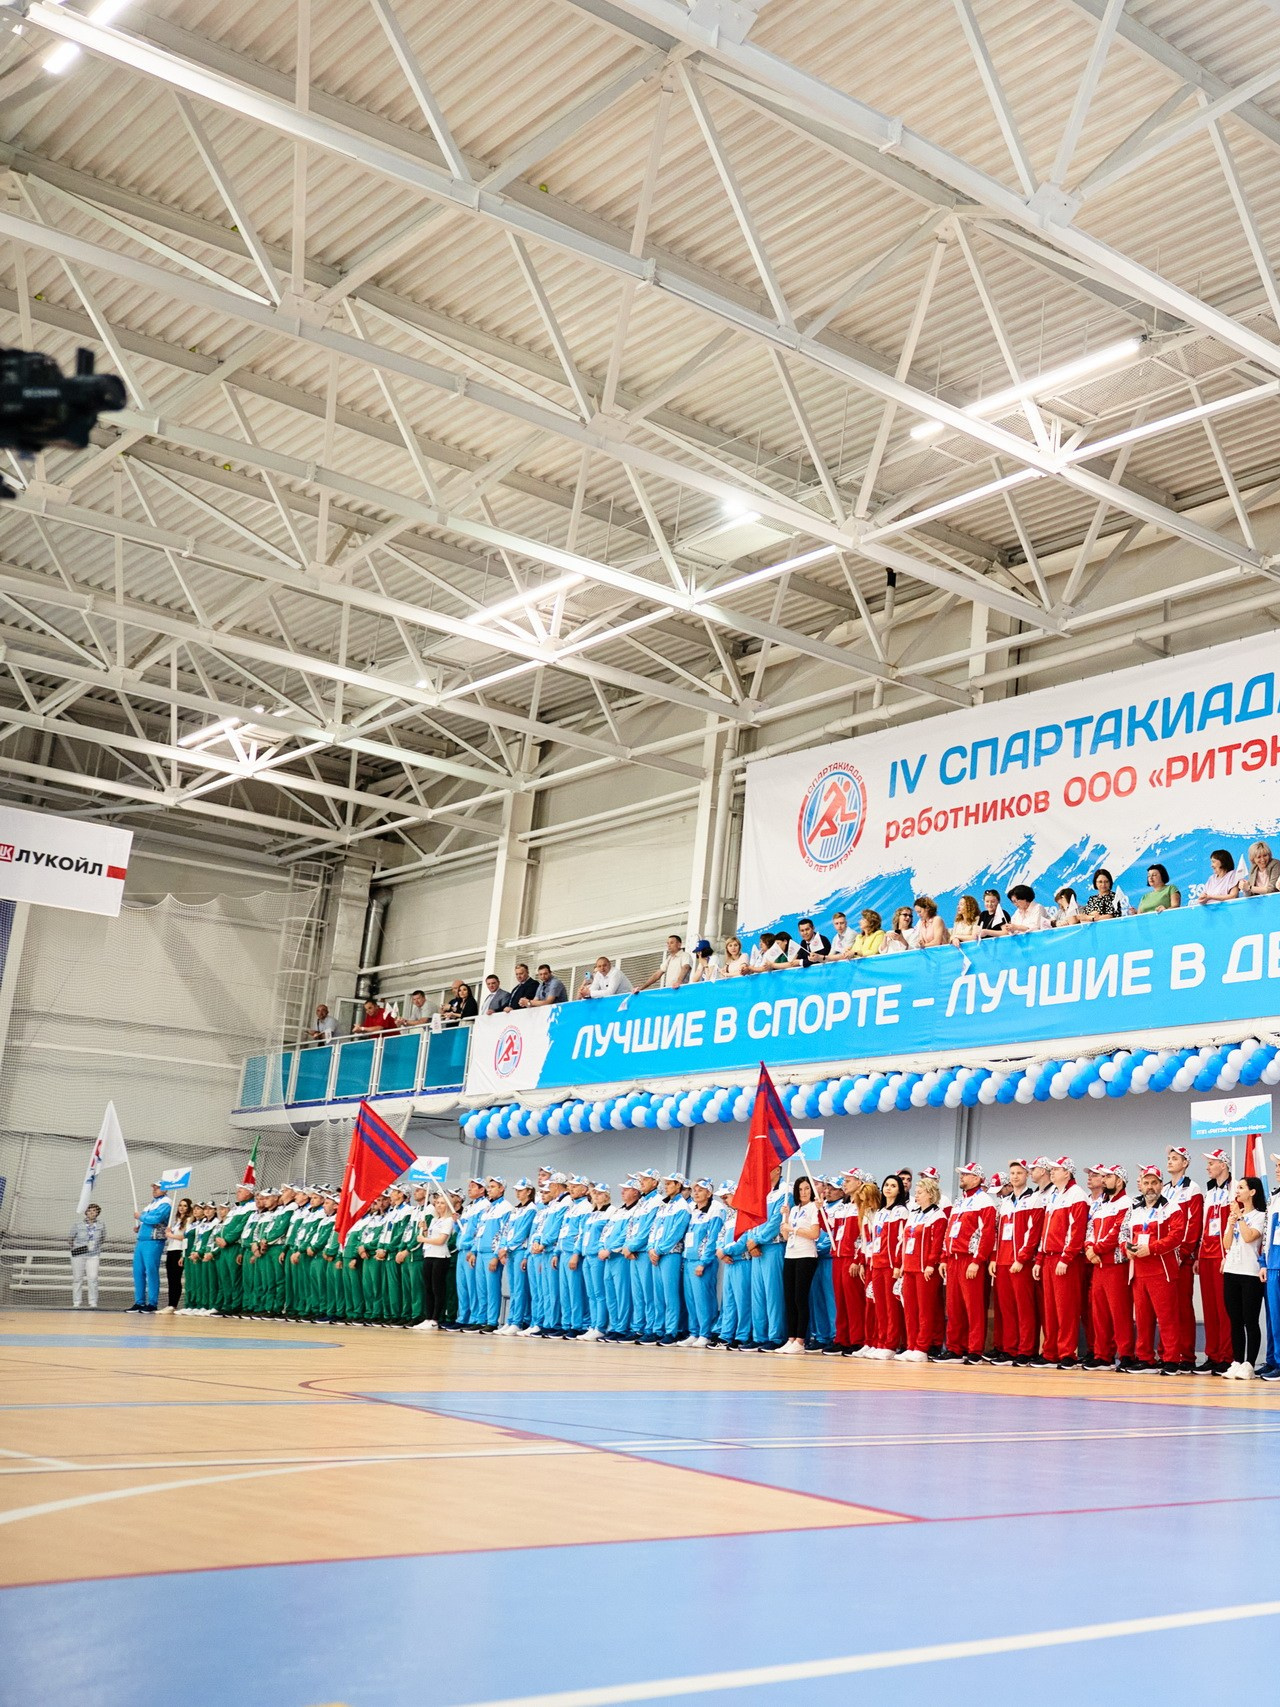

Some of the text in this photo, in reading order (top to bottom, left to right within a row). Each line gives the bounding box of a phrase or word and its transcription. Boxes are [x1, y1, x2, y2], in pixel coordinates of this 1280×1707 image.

[807, 762, 863, 794] СПАРТАКИАДА
[888, 754, 927, 798] IV
[885, 790, 1050, 848] работников
[1063, 765, 1137, 807] ООО
[15, 848, 103, 876] ЛУКОЙЛ
[815, 863, 828, 872] ЛЕТ
[571, 1010, 707, 1060] ЛУЧШИЕ
[713, 1006, 738, 1044] В
[748, 984, 902, 1039] СПОРТЕ
[944, 948, 1154, 1017] ЛУЧШИЕ
[1170, 942, 1207, 990] В
